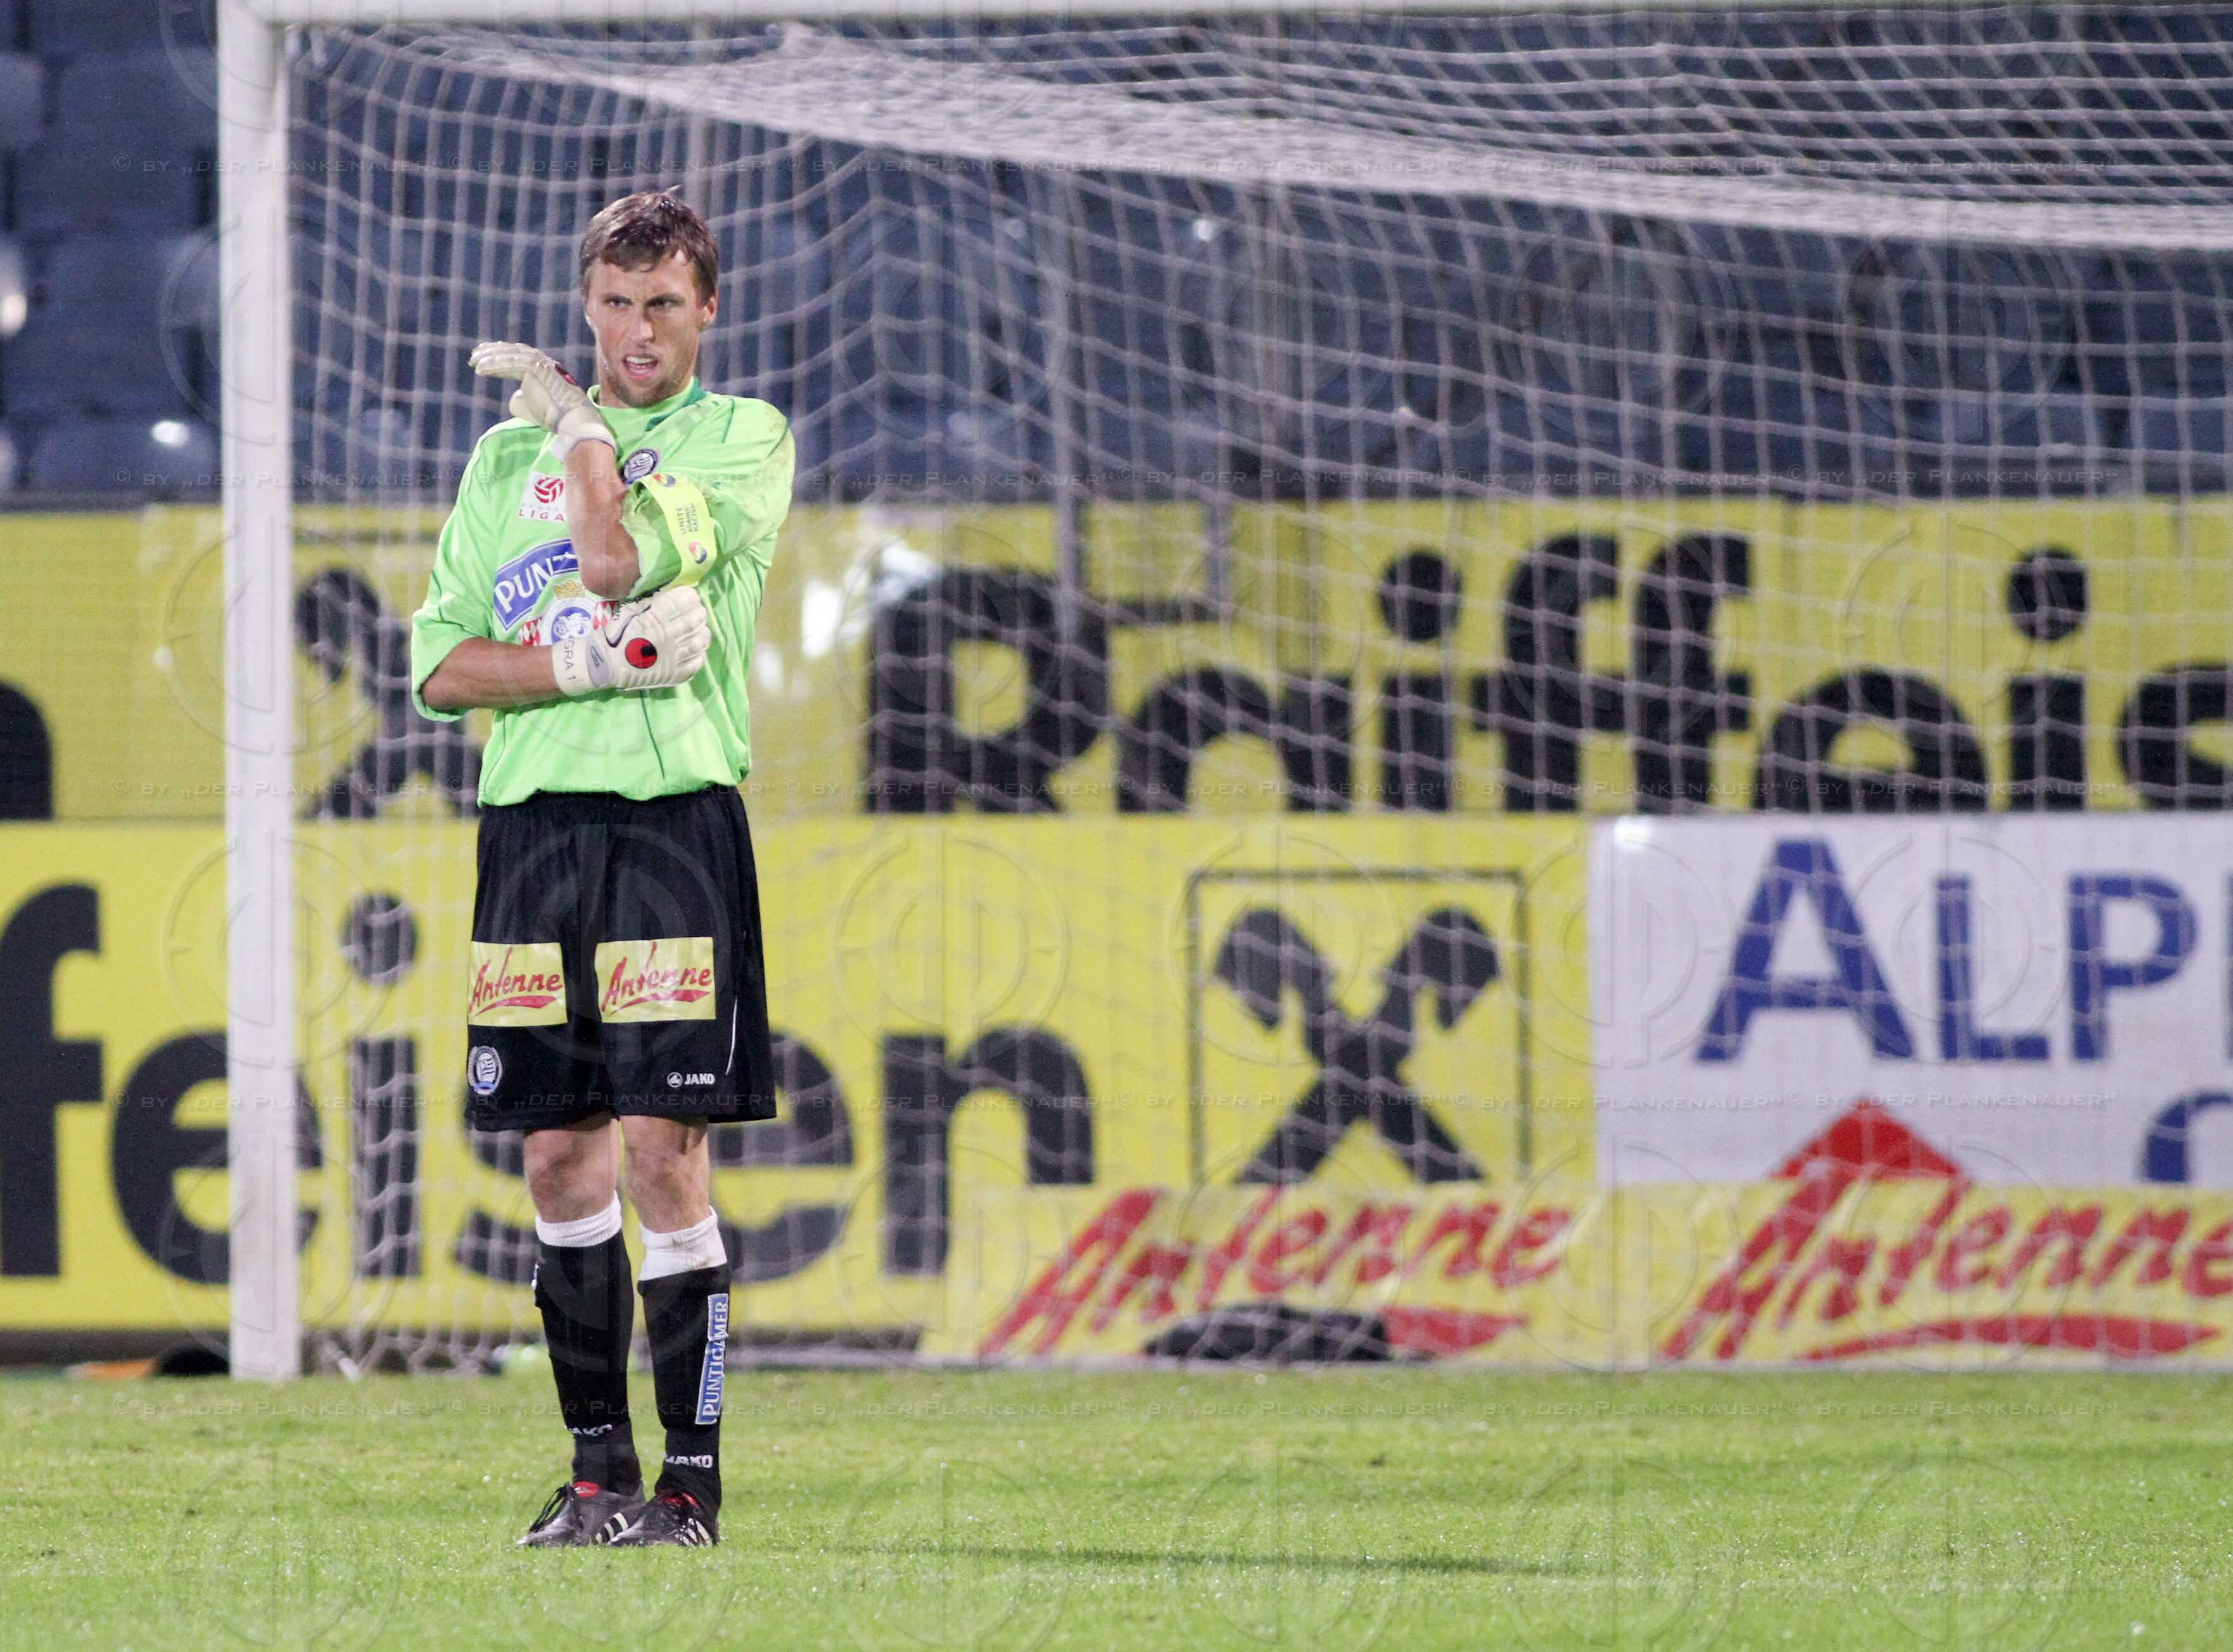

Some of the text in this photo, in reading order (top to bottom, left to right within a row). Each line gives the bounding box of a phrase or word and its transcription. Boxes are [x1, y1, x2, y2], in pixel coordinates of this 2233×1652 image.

[519, 509, 564, 521] LIGA
[469, 948, 563, 1013] Antenne
[601, 942, 712, 1012] Antenne
[1693, 836, 2233, 1063] ALP
[684, 1073, 715, 1085] JAKO
[978, 1186, 1574, 1356] Antenne
[1657, 1174, 2233, 1359] Antenne
